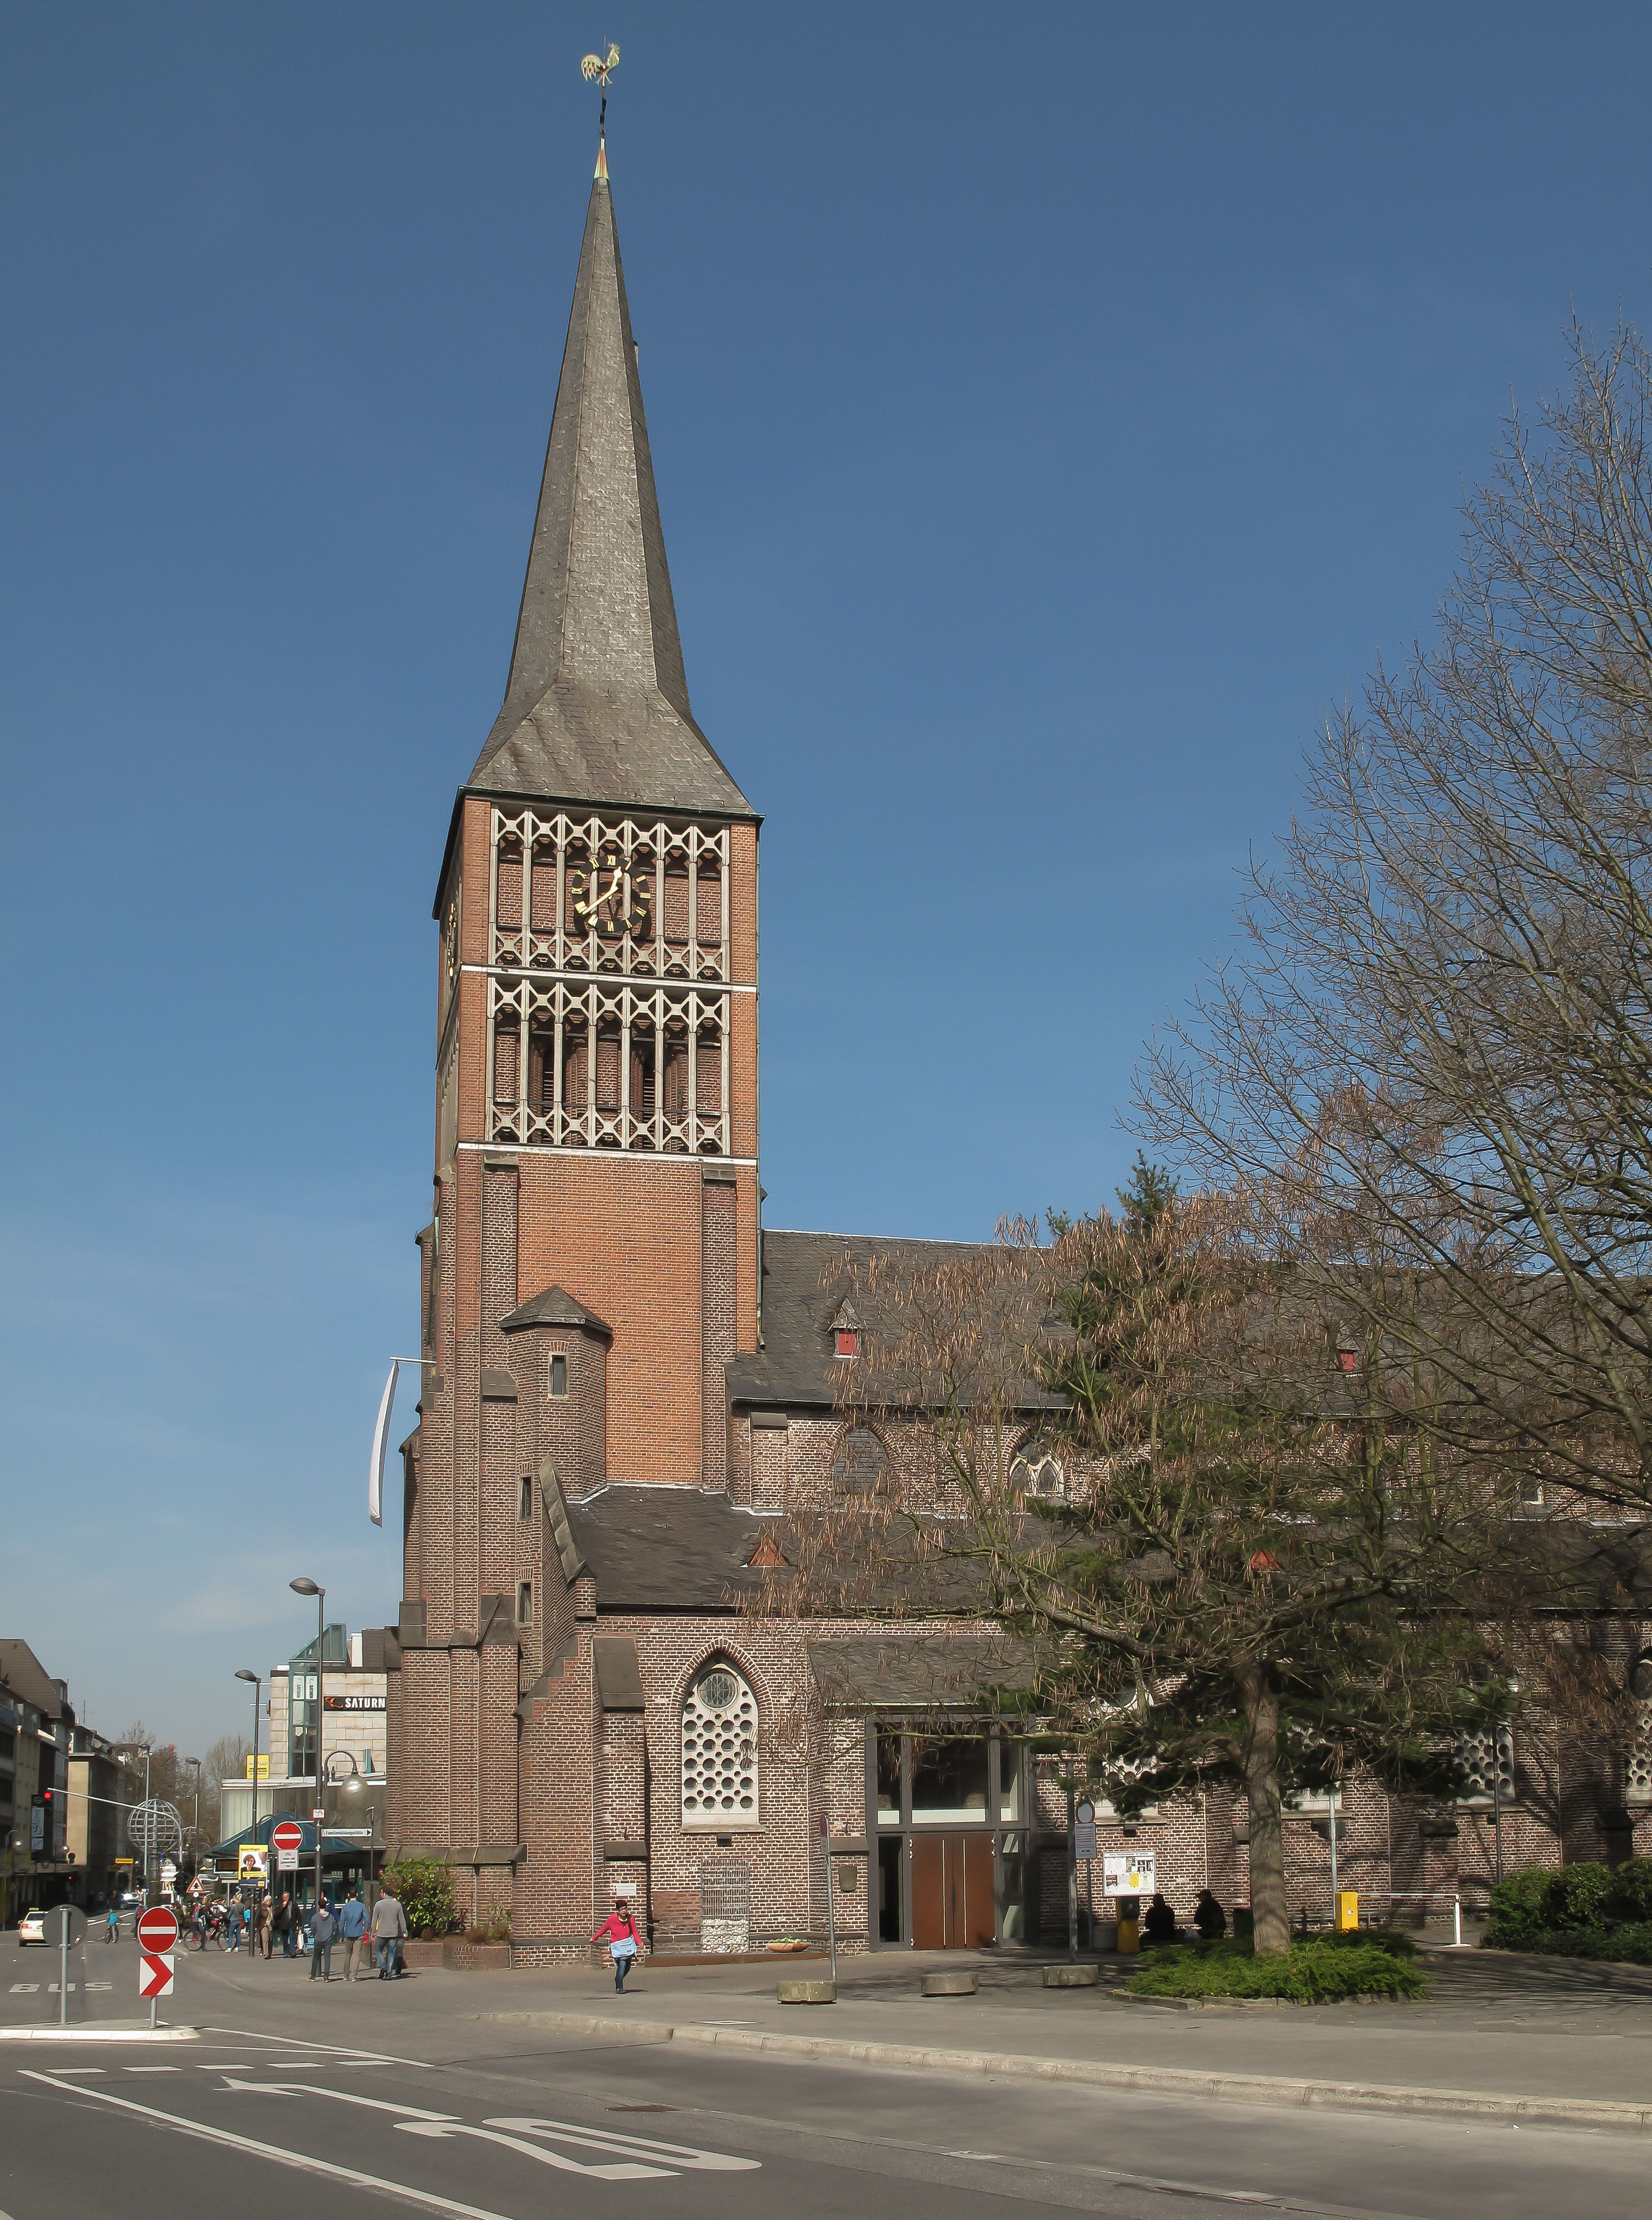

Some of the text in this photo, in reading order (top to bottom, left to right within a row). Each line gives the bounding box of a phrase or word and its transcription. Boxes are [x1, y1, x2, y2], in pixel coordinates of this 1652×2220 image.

[607, 855, 616, 865] XII
[345, 1698, 385, 1708] SATURN
[8, 1982, 113, 1993] BUS
